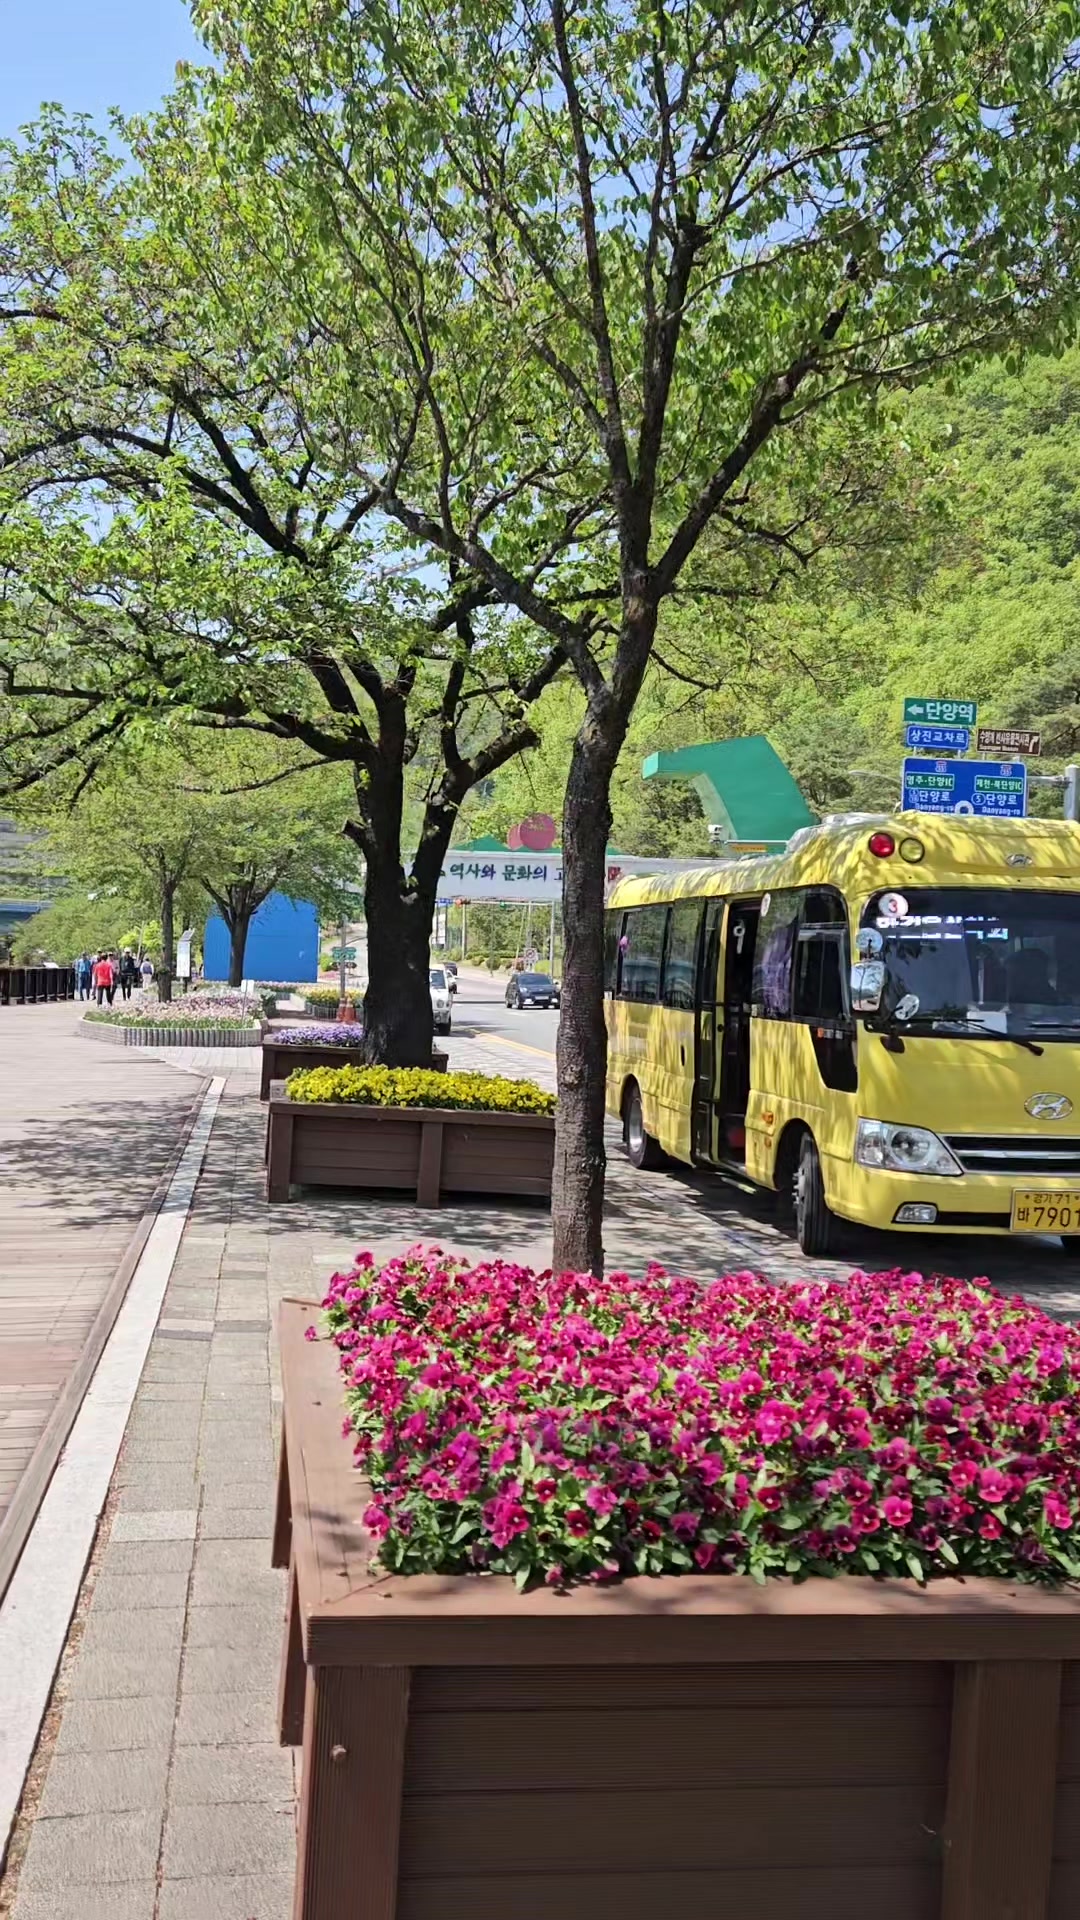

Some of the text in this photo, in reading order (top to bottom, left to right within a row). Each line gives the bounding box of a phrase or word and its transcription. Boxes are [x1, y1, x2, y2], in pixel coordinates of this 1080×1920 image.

[926, 702, 974, 722] 단양역
[910, 731, 966, 743] 상진교차로
[919, 790, 951, 803] 단양로
[986, 794, 1018, 807] 단양로
[450, 863, 496, 881] 역사와
[502, 864, 548, 882] 문화의
